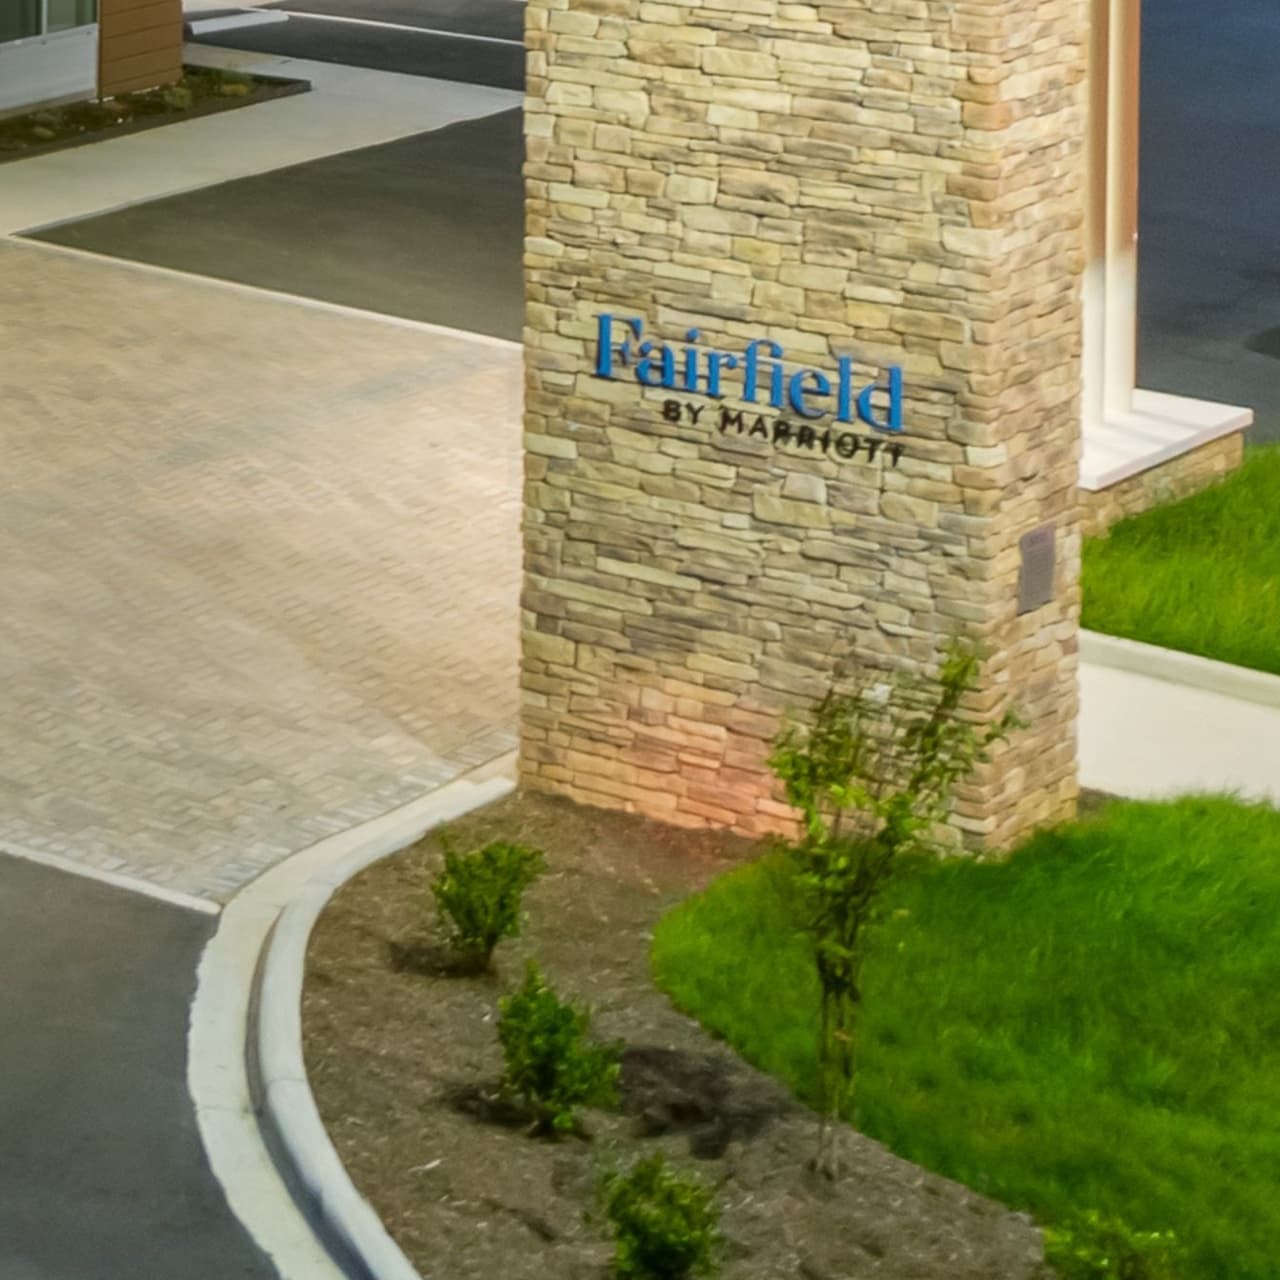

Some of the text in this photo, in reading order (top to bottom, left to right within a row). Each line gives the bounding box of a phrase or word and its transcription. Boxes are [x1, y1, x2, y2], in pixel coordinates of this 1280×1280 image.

[593, 313, 904, 432] Fairfield
[663, 400, 906, 466] BY MARRIOTT
